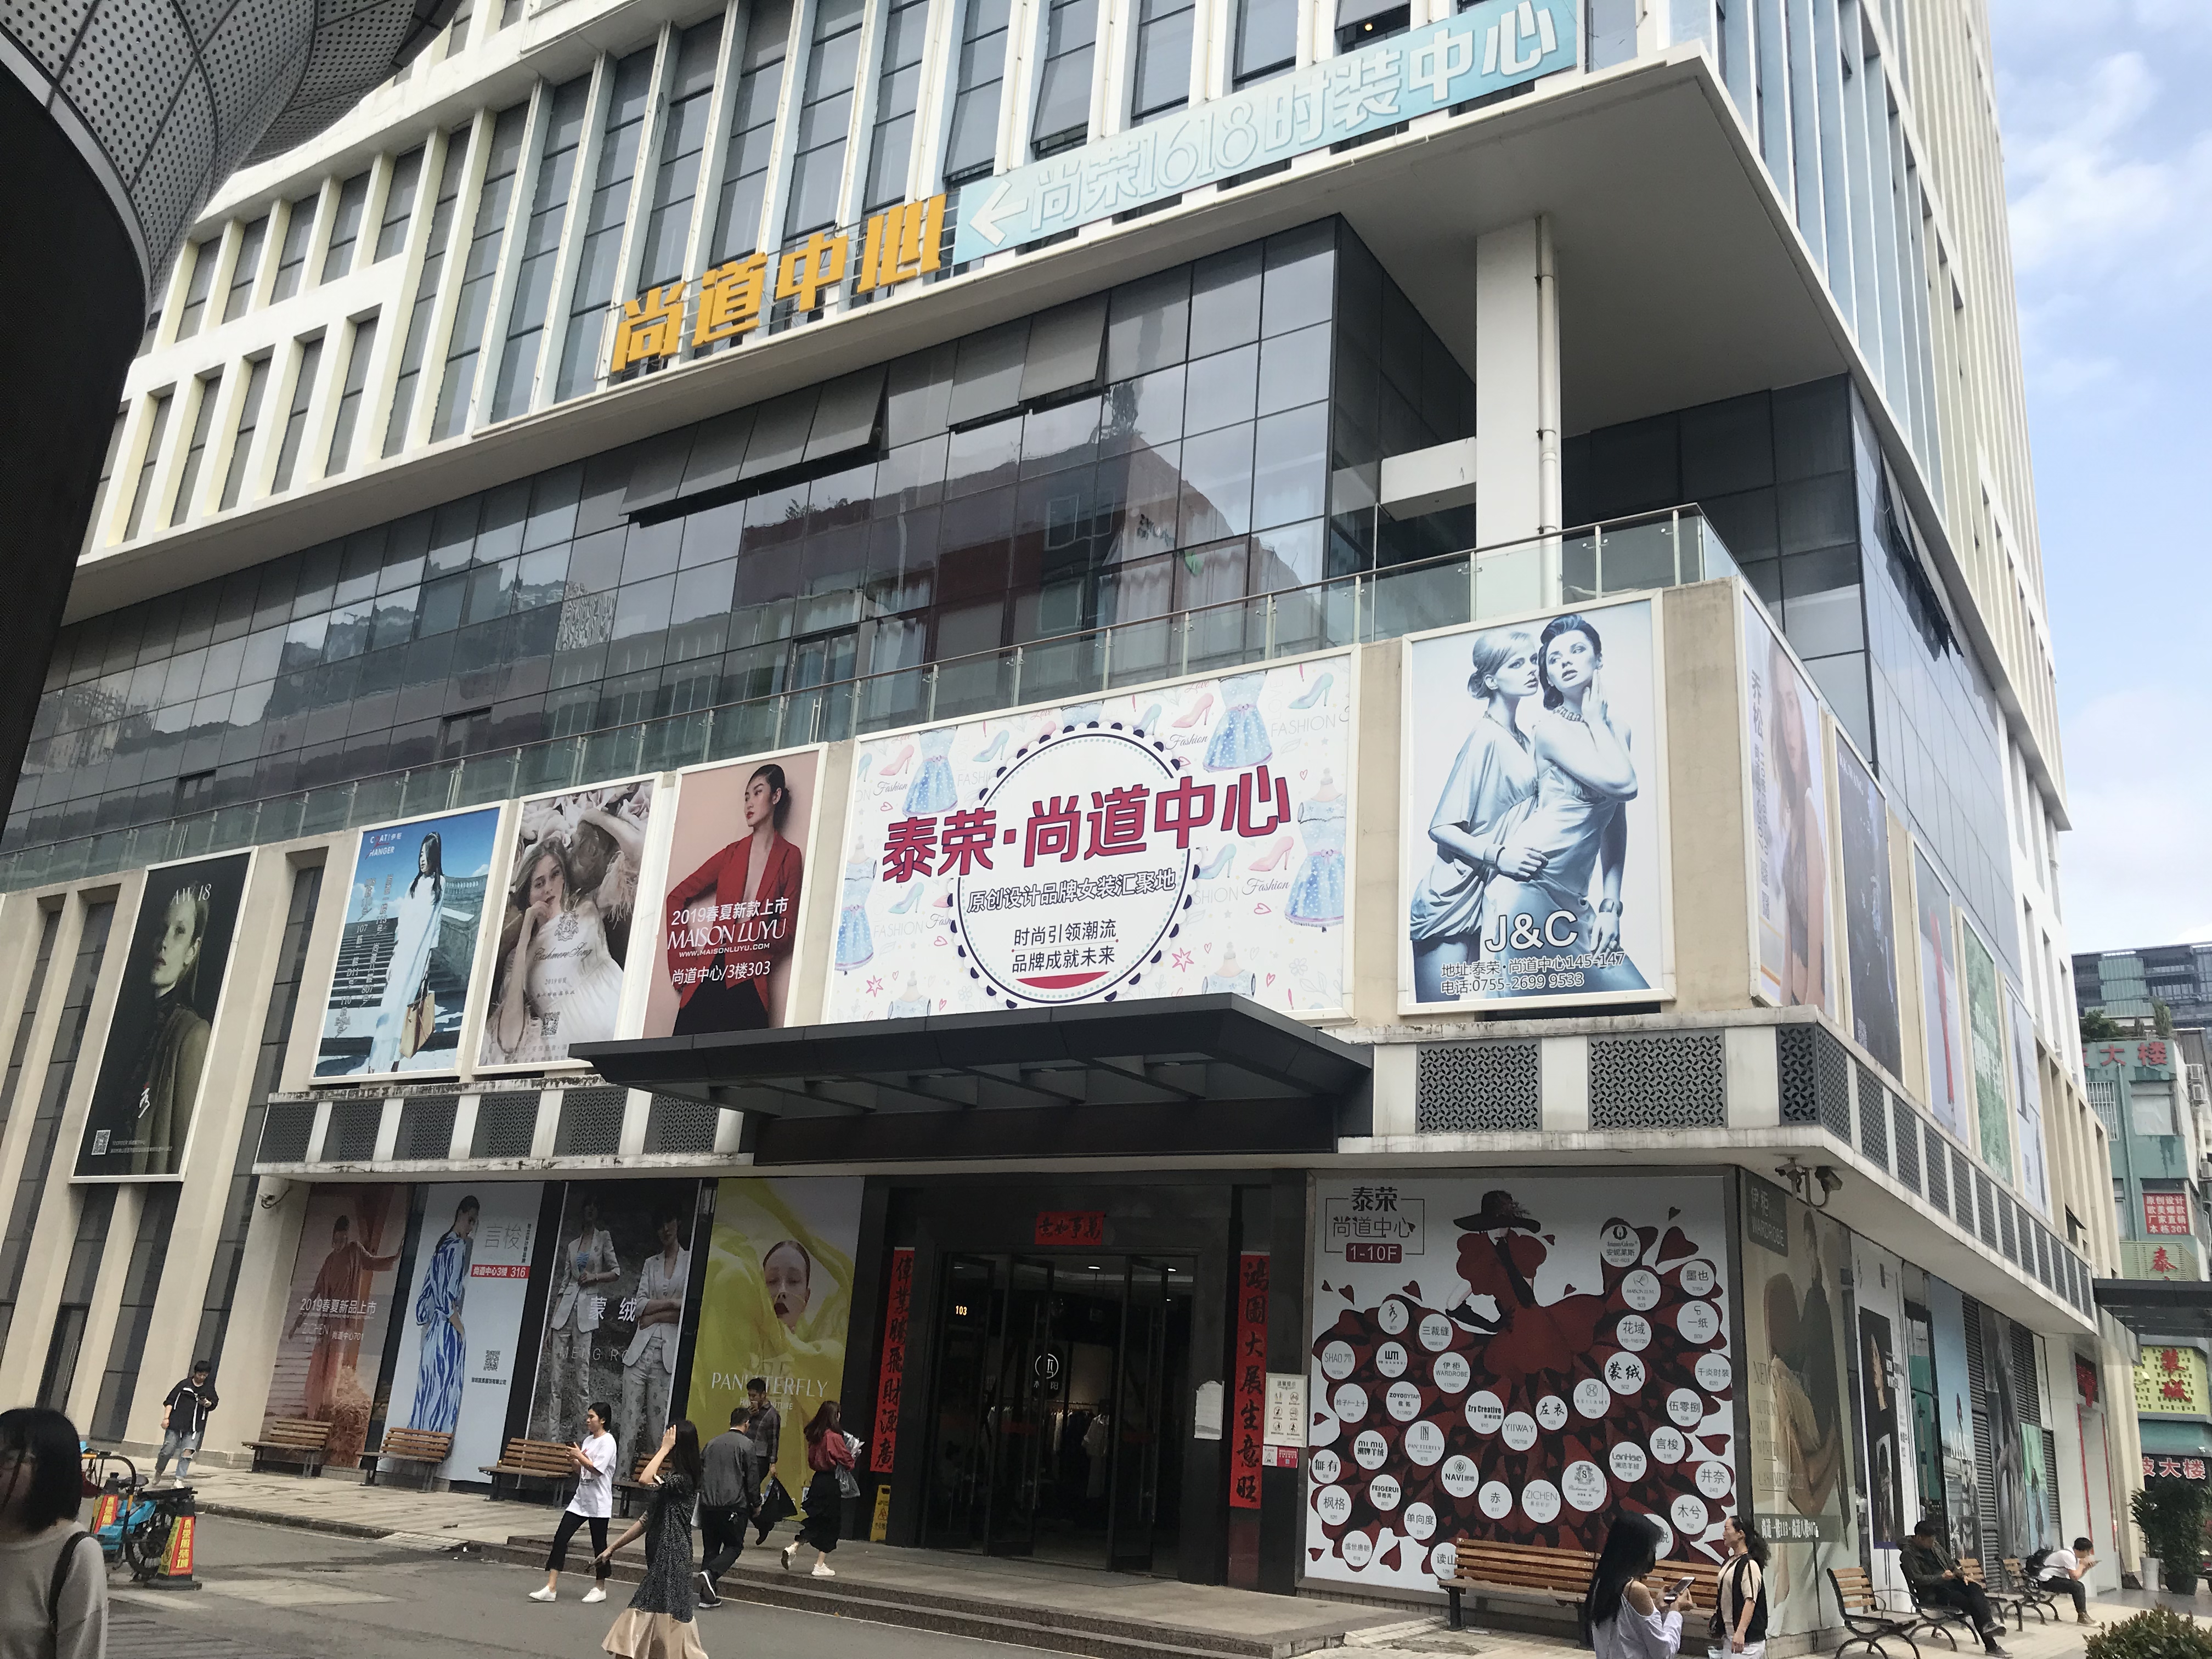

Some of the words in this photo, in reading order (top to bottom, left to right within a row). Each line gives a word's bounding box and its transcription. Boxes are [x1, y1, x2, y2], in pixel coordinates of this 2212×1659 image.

[1030, 1, 1558, 230] 尚荣1618时装中心
[611, 193, 946, 372] 尚道中心
[1271, 714, 1336, 737] FASHION
[1165, 733, 1209, 751] Fashion
[873, 781, 908, 796] Fashion
[883, 765, 1290, 883] 泰荣·尚道中心
[369, 846, 394, 857] HANGER
[170, 886, 196, 905] AW
[198, 883, 211, 901] 18
[967, 868, 1176, 913] 原创设计品牌女装汇聚地
[1242, 878, 1290, 895] Fashion
[671, 896, 788, 926] 2019春夏新款上市
[667, 924, 736, 950] MAISON
[737, 919, 787, 942] LUYU
[873, 921, 923, 938] FASHION
[1014, 919, 1116, 946] 时尚引领潮流
[1484, 909, 1578, 952] J&C
[533, 947, 570, 962] Cashmere
[679, 943, 770, 958] WWW.MAISONLUYU.COM
[1012, 946, 1115, 973] 品牌成就未来
[672, 961, 770, 985] 尚道中心/3楼303
[1549, 972, 1584, 987] 9533
[1351, 1187, 1398, 1211] 泰荣
[2147, 1195, 2184, 1205] 原创设计
[1333, 1216, 1413, 1238] 尚道中心
[485, 1223, 521, 1249] 言梭
[1350, 1245, 1398, 1261] 1-10F
[510, 1267, 526, 1278] 316
[1686, 1270, 1709, 1282] 墨也
[300, 1298, 377, 1315] 2019春夏新品上市
[589, 1296, 637, 1322] 蒙绒
[955, 1305, 967, 1316] 103
[1623, 1321, 1645, 1335] 花域
[1688, 1318, 1708, 1328] 一纸
[1422, 1326, 1449, 1336] 三裁缝
[1324, 1352, 1342, 1363] SHAO
[1608, 1361, 1642, 1382] 蒙绒
[1477, 1405, 1502, 1414] Creative
[1539, 1402, 1565, 1417] 左衣
[1669, 1401, 1701, 1413] 伍零捌
[1505, 1423, 1534, 1433] YIIWAY
[1656, 1438, 1678, 1451] 言梭
[1445, 1473, 1464, 1481] NAVI
[1701, 1469, 1725, 1485] 井奈
[1372, 1485, 1399, 1493] FEIGERUI
[1526, 1490, 1558, 1501] ZICHEN
[1323, 1497, 1345, 1510] 枫格
[1491, 1492, 1500, 1503] 赤
[1406, 1513, 1434, 1525] 单向度
[1678, 1504, 1701, 1519] 木兮
